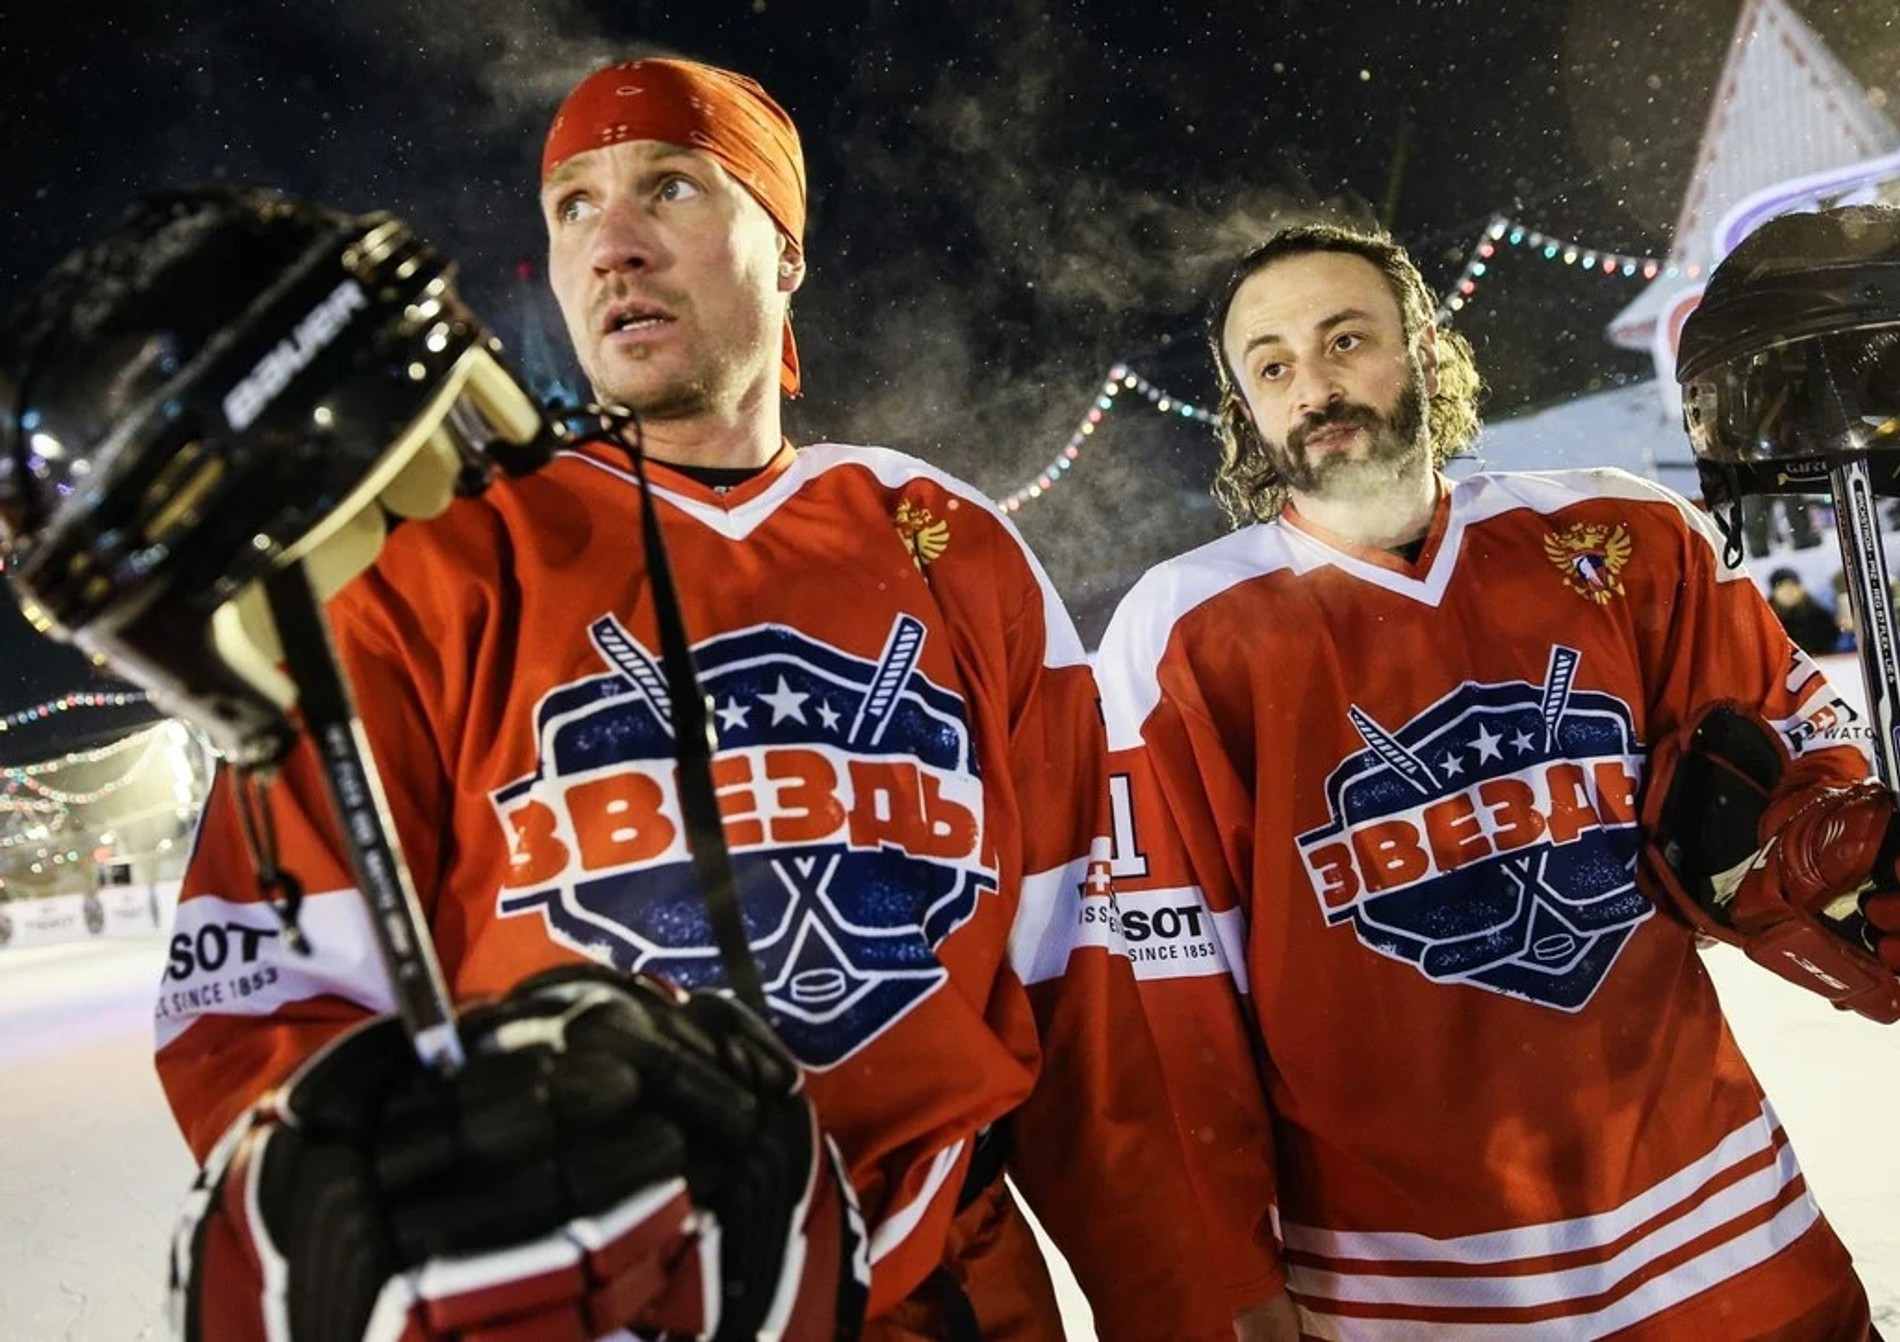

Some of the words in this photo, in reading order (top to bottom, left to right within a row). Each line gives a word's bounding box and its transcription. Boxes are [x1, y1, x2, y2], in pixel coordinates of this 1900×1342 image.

[162, 922, 279, 981] SOT
[1128, 945, 1179, 962] SINCE
[1183, 942, 1217, 959] 1853
[172, 982, 224, 1012] SINCE
[229, 966, 279, 998] 1853
